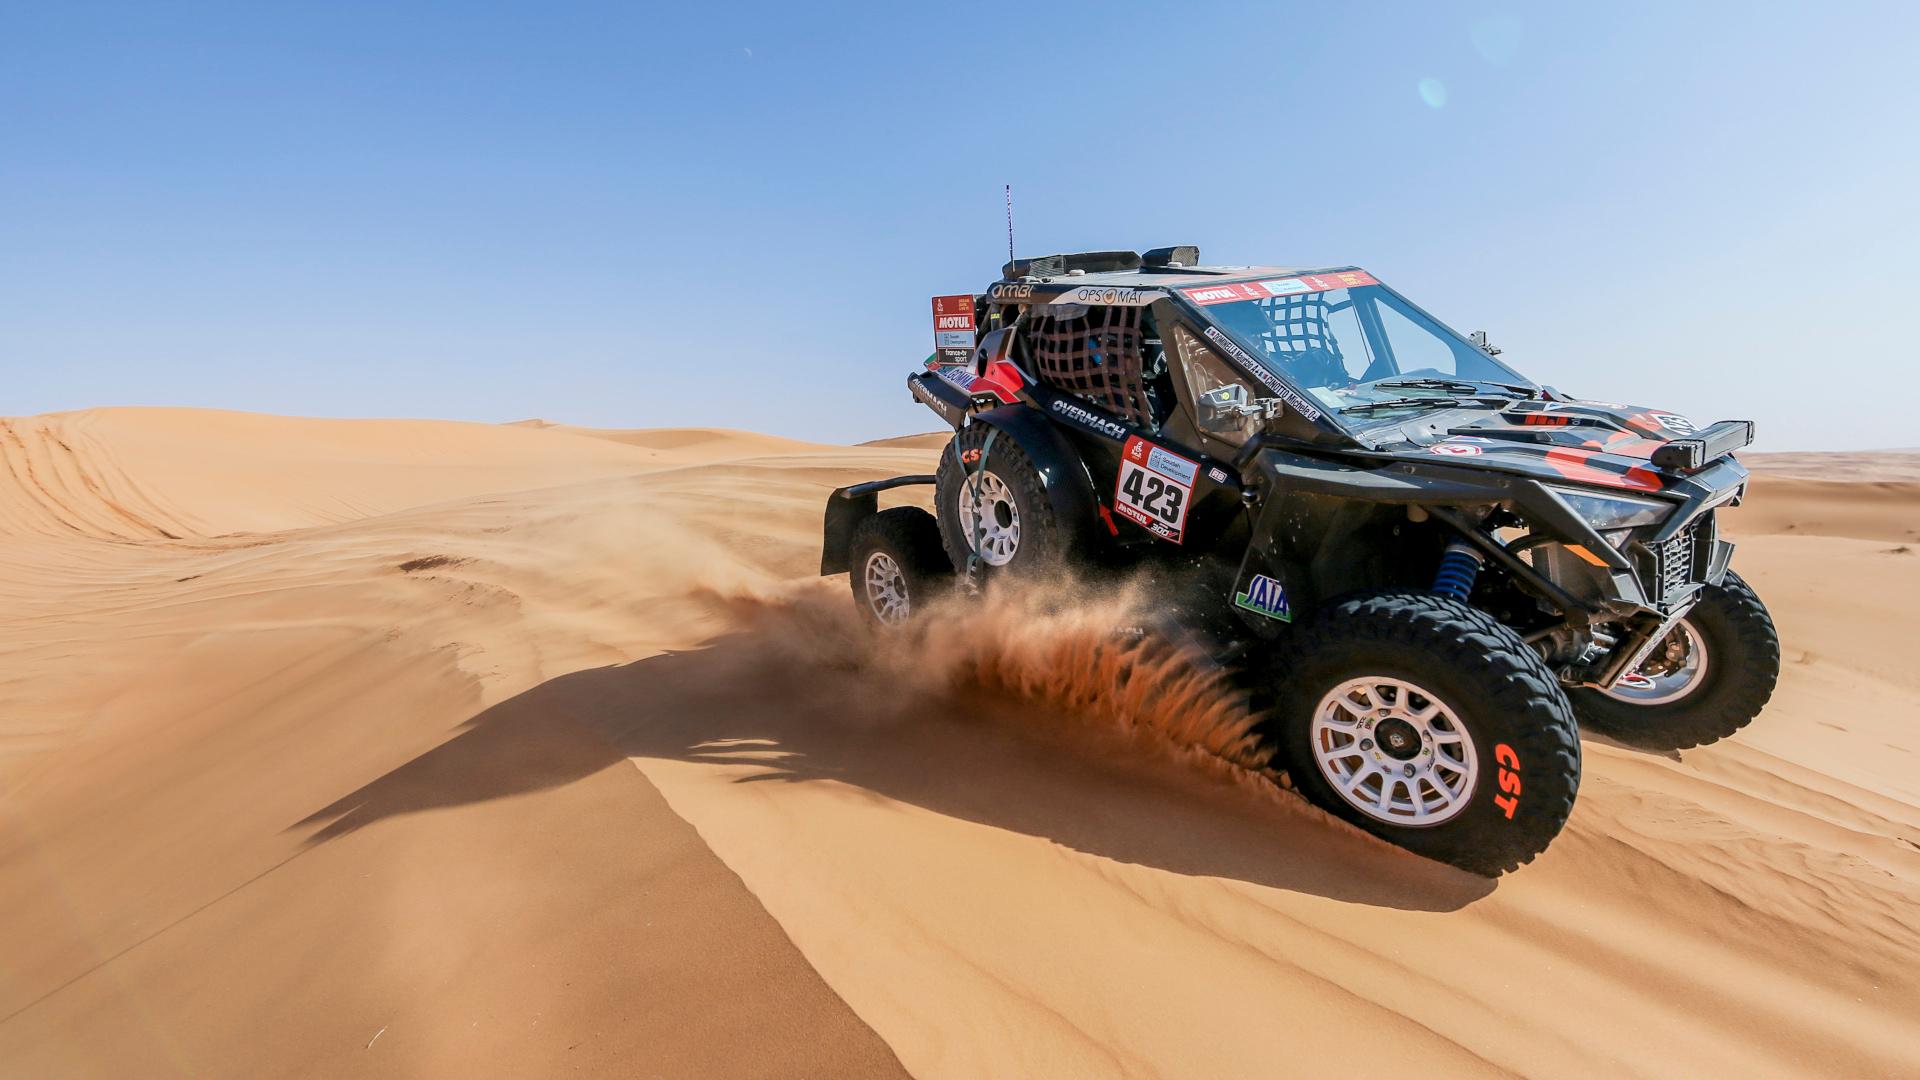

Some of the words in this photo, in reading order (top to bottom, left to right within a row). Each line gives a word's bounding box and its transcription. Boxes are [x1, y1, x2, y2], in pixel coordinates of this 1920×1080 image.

[1193, 290, 1236, 302] MOTUL
[939, 316, 970, 329] MOTUL
[1265, 376, 1288, 399] CINOTTO
[1052, 400, 1127, 439] OVERMACH
[961, 448, 984, 463] CS
[1122, 468, 1183, 524] 423
[1118, 503, 1148, 525] MOTUL
[1494, 743, 1522, 820] CST
